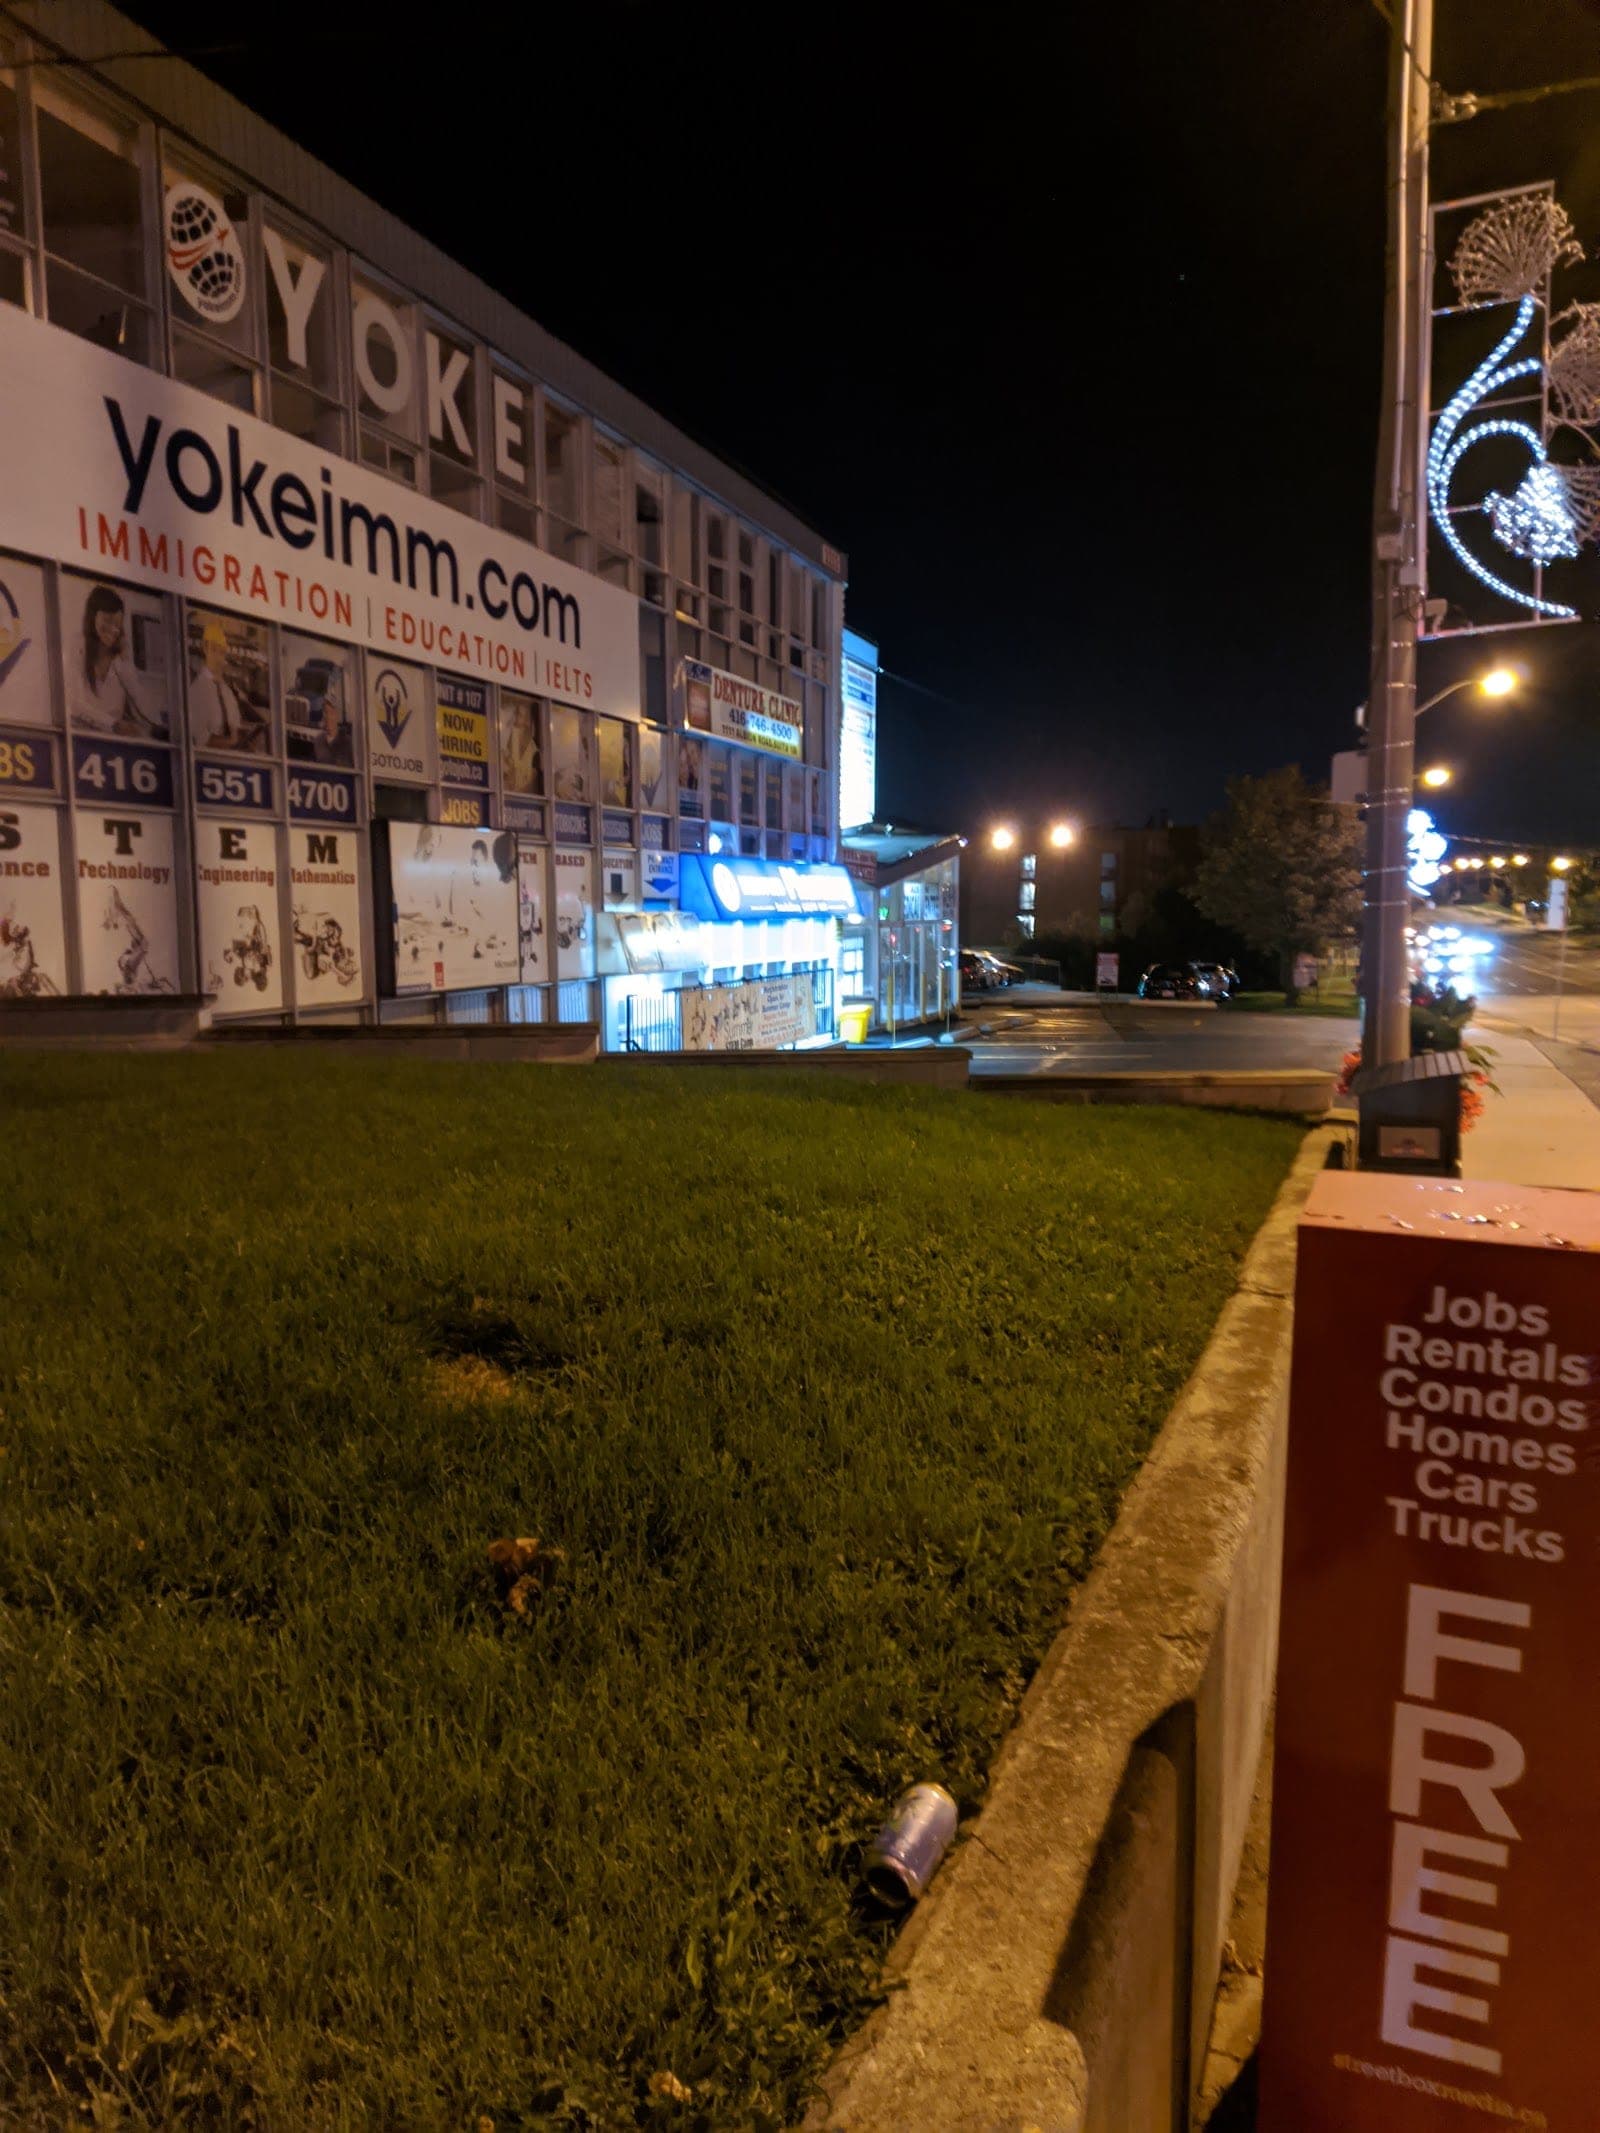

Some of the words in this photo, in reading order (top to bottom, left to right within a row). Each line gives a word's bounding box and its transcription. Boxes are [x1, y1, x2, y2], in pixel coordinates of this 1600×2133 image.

[263, 227, 526, 484] YOKE
[103, 396, 582, 650] yokeimm.com
[78, 507, 353, 628] IMMIGRATION
[386, 607, 525, 679] EDUCATION
[546, 664, 593, 699] IELTS
[443, 713, 474, 733] NOW
[78, 752, 158, 793] 416
[202, 766, 264, 804] 551
[288, 777, 349, 813] 4700
[442, 798, 480, 824] JOBS
[79, 860, 171, 884] Technology
[104, 819, 143, 855] T
[219, 828, 247, 860] E
[307, 834, 338, 864] M
[555, 853, 585, 867] BASED
[1424, 1285, 1550, 1337] Jobs
[1384, 1323, 1591, 1386] Rentals
[1379, 1367, 1590, 1432] Condos
[1385, 1410, 1577, 1476] Homes
[1415, 1459, 1538, 1514] Cars
[1384, 1496, 1565, 1563] Trucks
[1380, 1583, 1532, 2077] FREE
